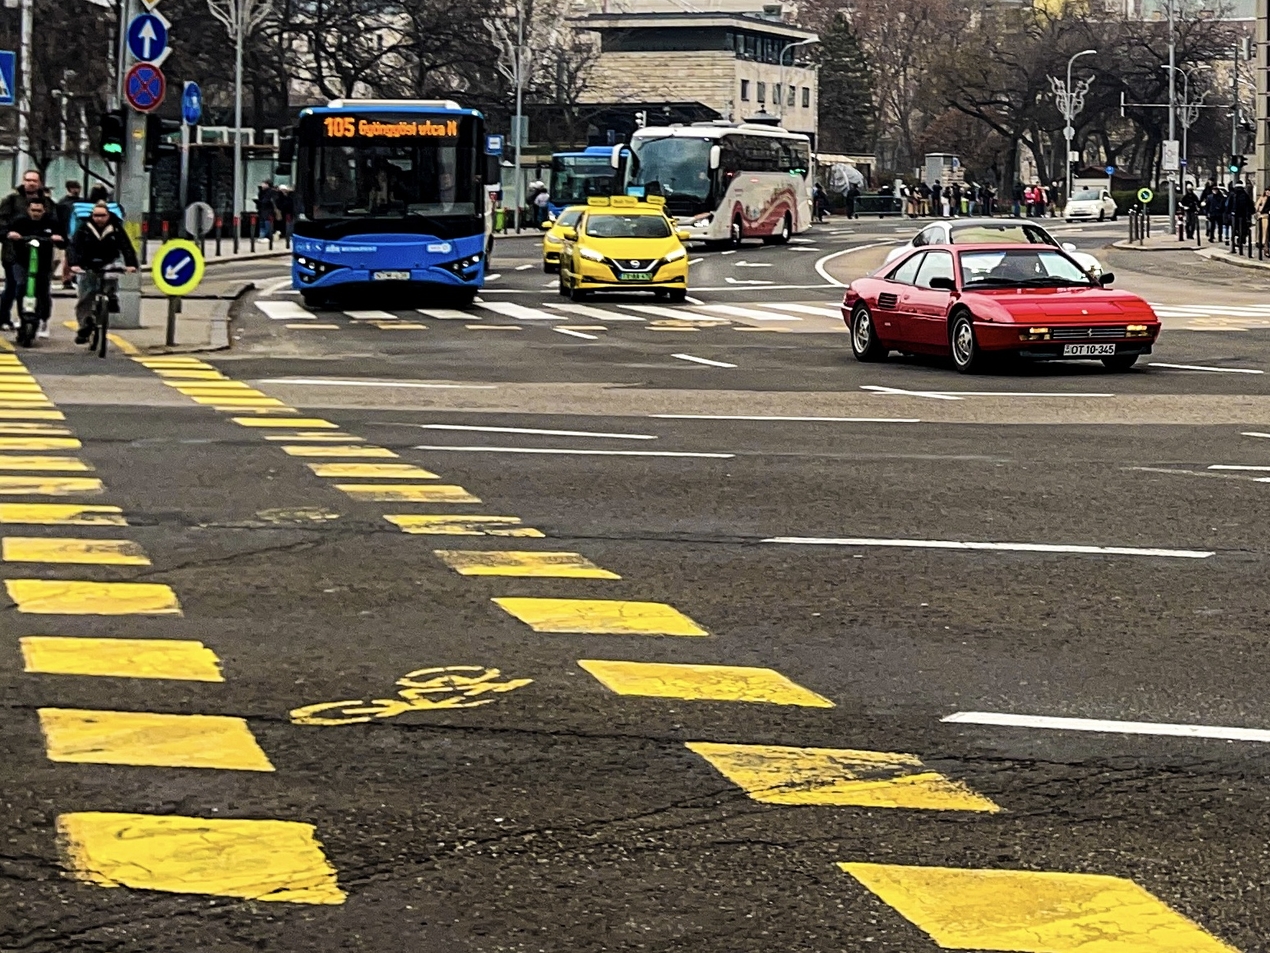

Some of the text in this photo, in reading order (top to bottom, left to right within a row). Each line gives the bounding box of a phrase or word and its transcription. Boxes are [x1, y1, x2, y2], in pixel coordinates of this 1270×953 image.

[324, 117, 355, 137] 105
[418, 120, 445, 136] utca
[1071, 345, 1085, 354] OT
[1086, 345, 1114, 354] 10-345
